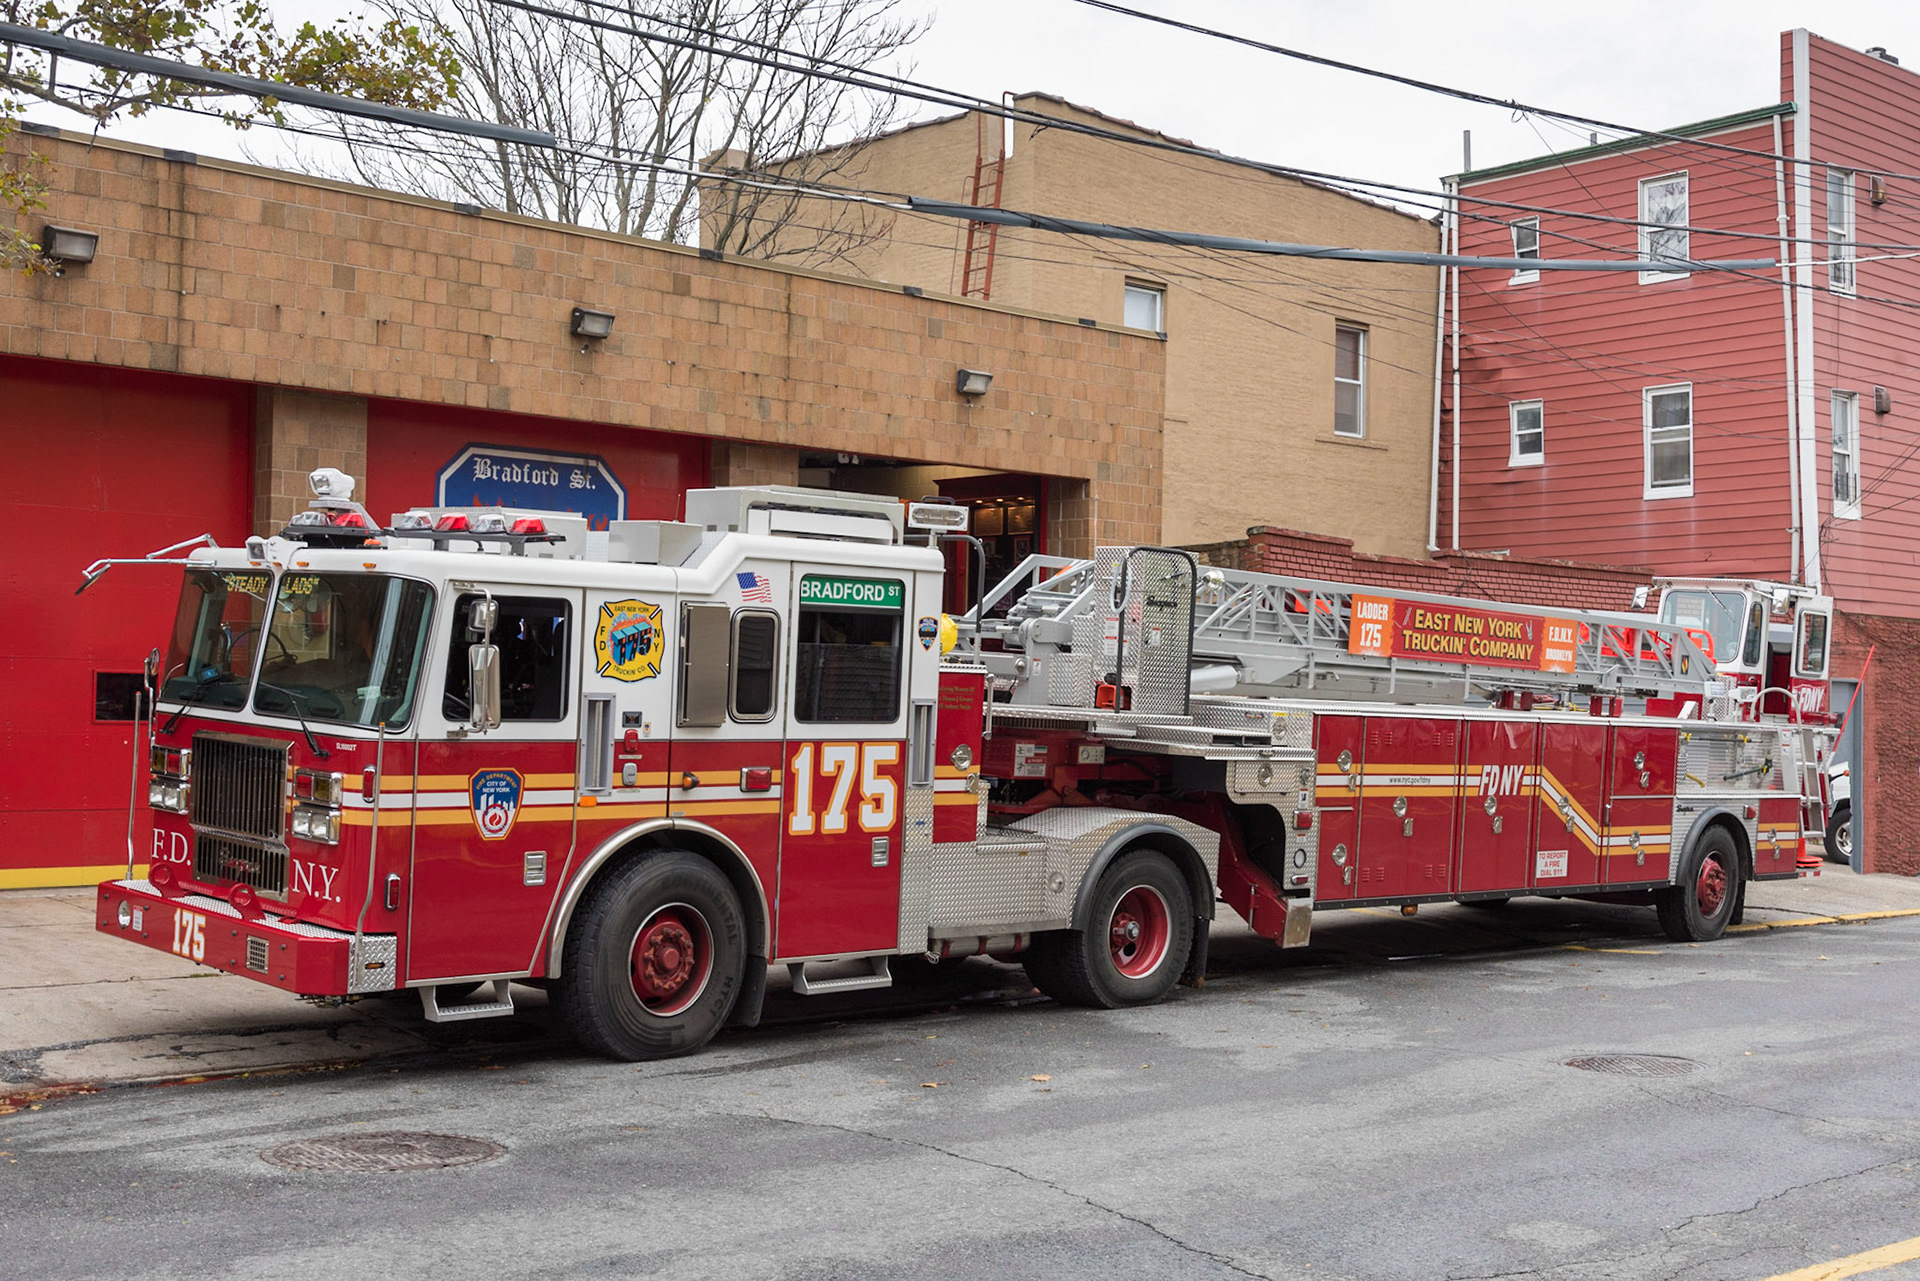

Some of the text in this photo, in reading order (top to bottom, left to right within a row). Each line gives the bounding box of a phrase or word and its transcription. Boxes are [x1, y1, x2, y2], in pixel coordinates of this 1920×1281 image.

[473, 457, 596, 490] Bradford St.
[800, 581, 900, 601] BRADFORD ST
[1357, 601, 1389, 621] LADDER
[1415, 608, 1524, 640] EAST NEW YORK
[1360, 623, 1383, 648] 175
[1402, 629, 1535, 662] TRUCKIN' COMPANY
[1545, 648, 1573, 662] BROOKLYN
[1799, 687, 1825, 712] FDNY
[789, 742, 900, 836] 175
[1479, 765, 1524, 796] FDNY
[152, 828, 192, 867] F.D.
[292, 859, 342, 903] N.Y.
[172, 907, 206, 961] 175
